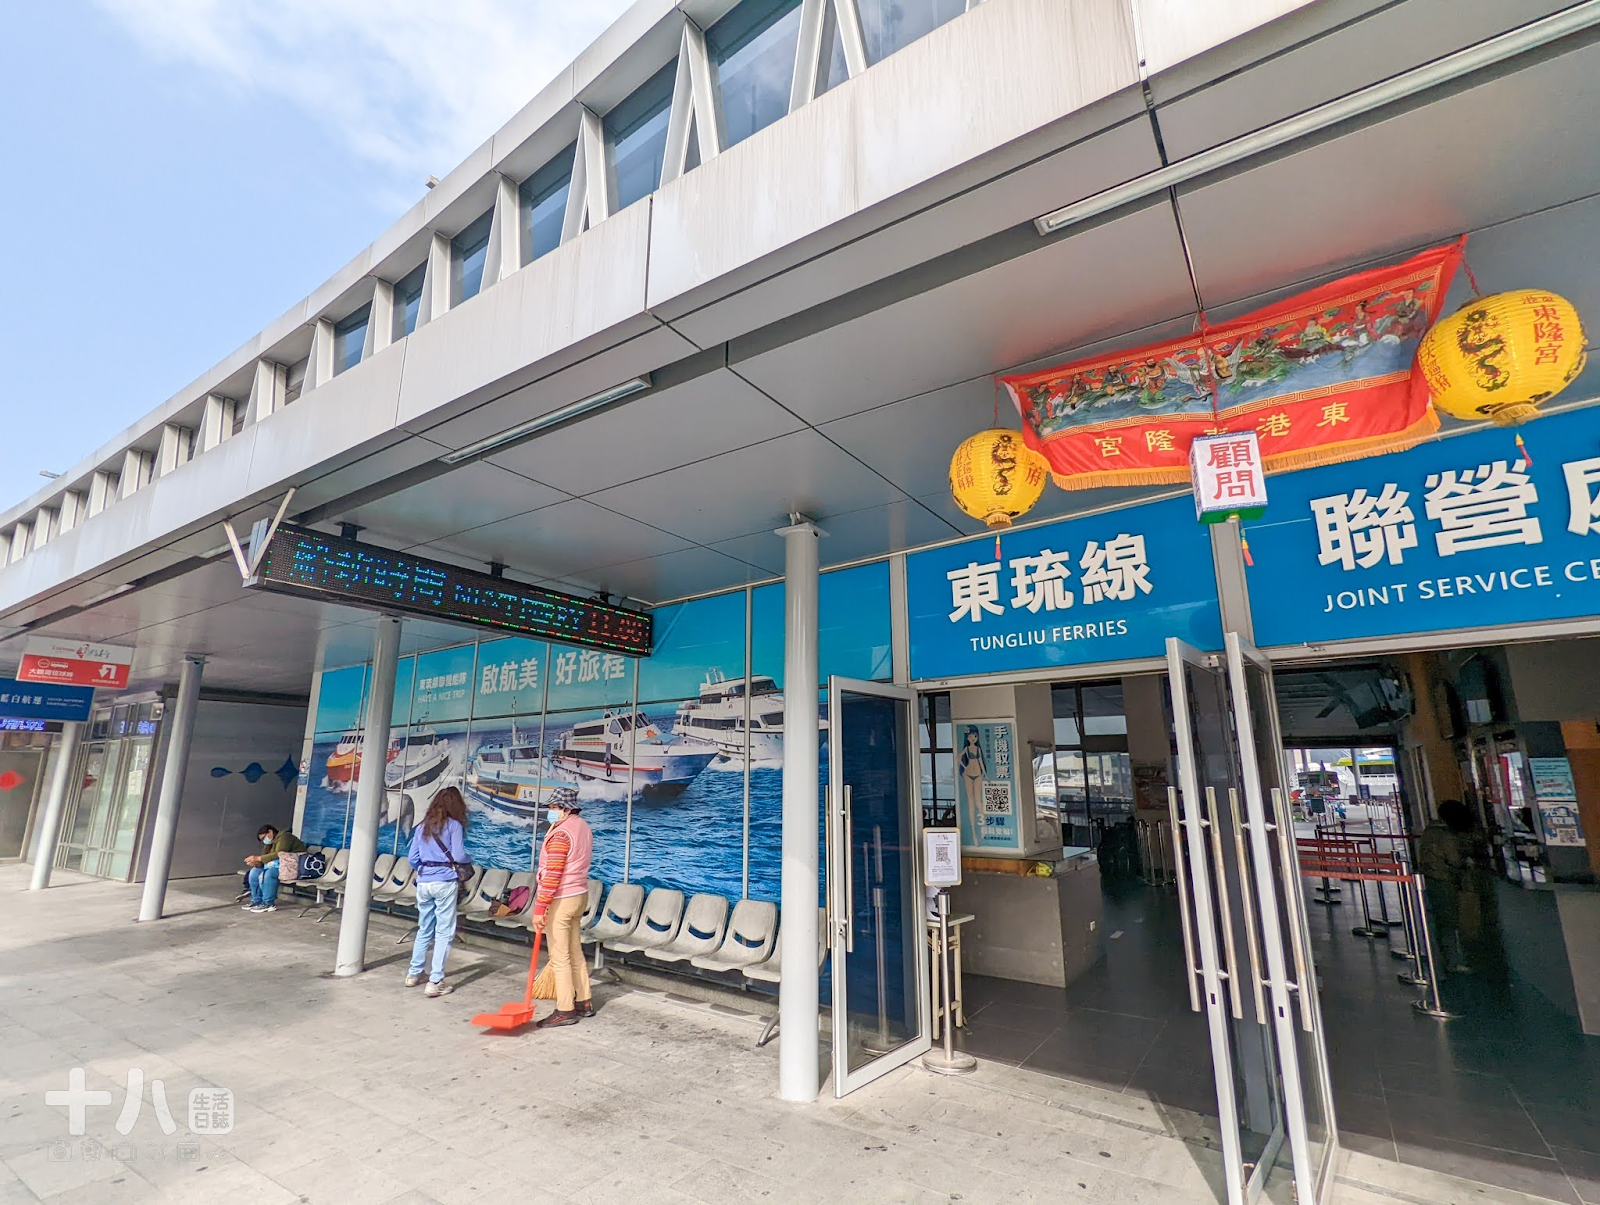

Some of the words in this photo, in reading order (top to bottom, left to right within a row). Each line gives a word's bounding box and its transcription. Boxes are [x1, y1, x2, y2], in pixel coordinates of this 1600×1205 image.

[1533, 305, 1564, 365] 東隆宮
[1207, 439, 1256, 499] 顧問
[946, 533, 1153, 623] 東琉線
[1324, 583, 1408, 612] JOINT
[1418, 565, 1553, 599] SERVICE
[970, 629, 1046, 652] TUNGLIU
[1052, 619, 1127, 643] FERRIES
[480, 657, 538, 695] 啟航美
[555, 650, 625, 686] 好旅程
[994, 725, 1010, 779] 手機取票
